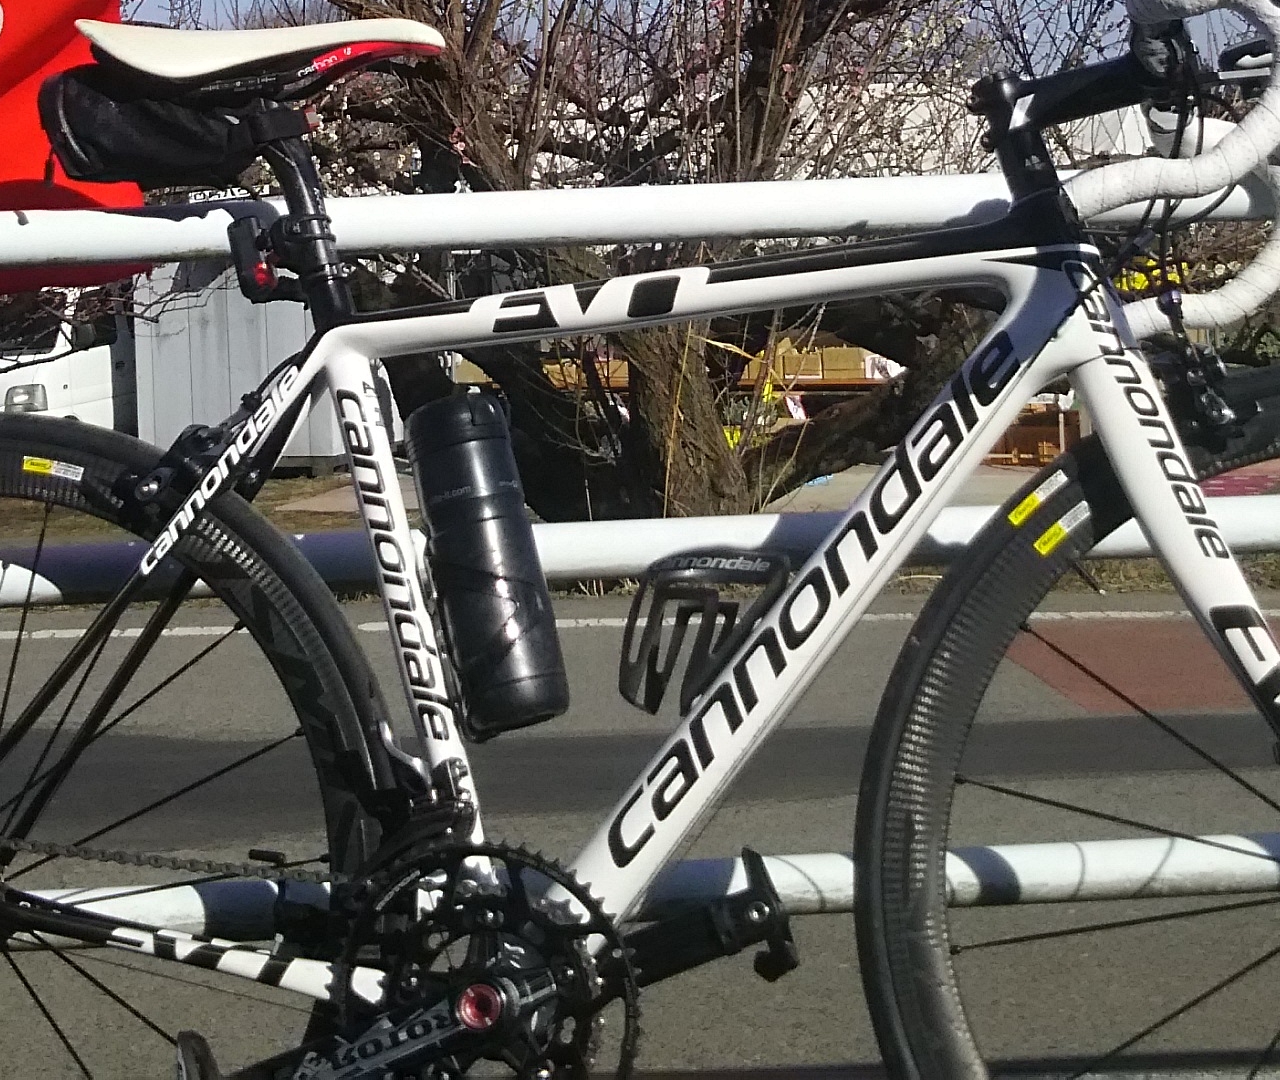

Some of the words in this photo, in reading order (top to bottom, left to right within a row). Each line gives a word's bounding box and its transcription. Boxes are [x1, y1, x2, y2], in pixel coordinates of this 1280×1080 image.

[139, 364, 301, 577] cannondale
[336, 387, 452, 743] cannondale
[1063, 260, 1231, 560] cannondale
[607, 331, 1022, 868] cannondale
